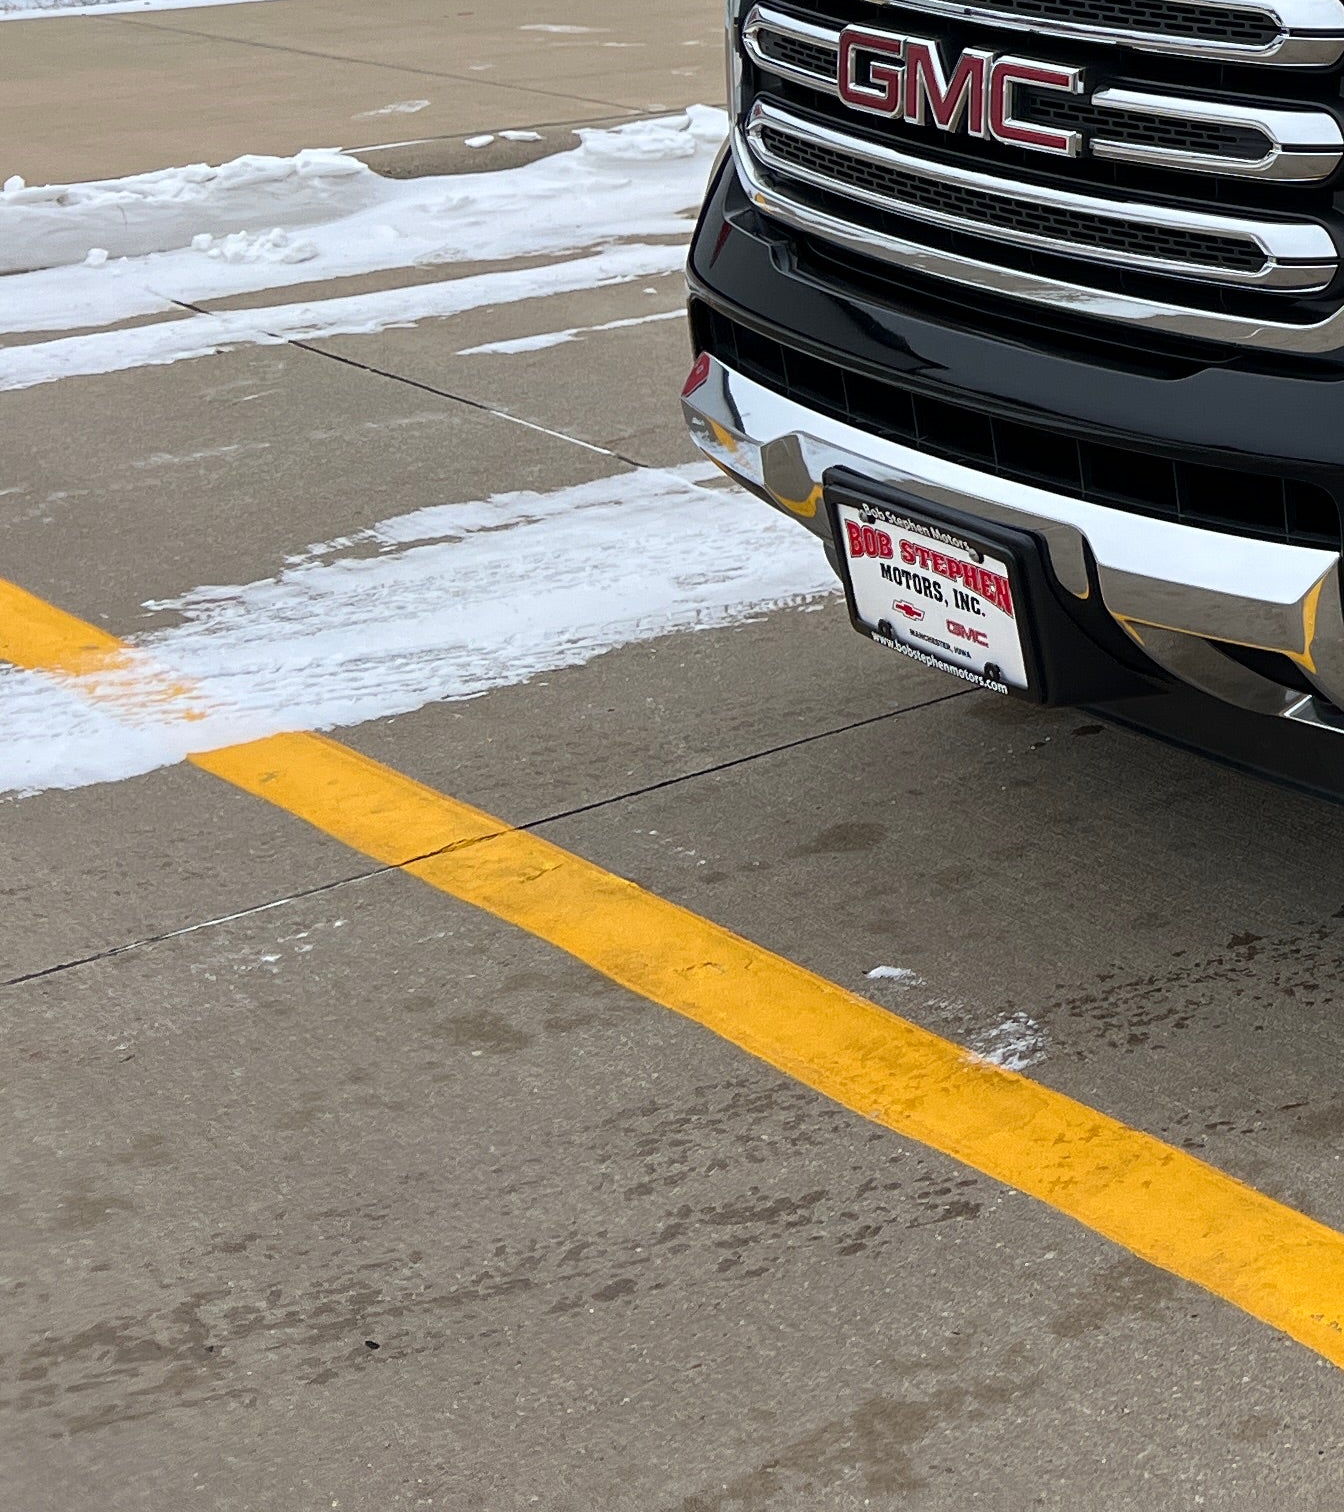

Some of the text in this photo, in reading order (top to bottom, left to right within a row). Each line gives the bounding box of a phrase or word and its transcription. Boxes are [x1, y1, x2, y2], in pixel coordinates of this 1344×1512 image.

[838, 24, 1084, 158] GMC
[862, 502, 970, 551] Bob Stephen Motors
[844, 518, 1014, 619] BOB STEPHEN
[880, 563, 986, 617] MOTORS, INC.
[871, 631, 1008, 694] www.bobstephenmotors.com
[945, 619, 989, 648] GMC
